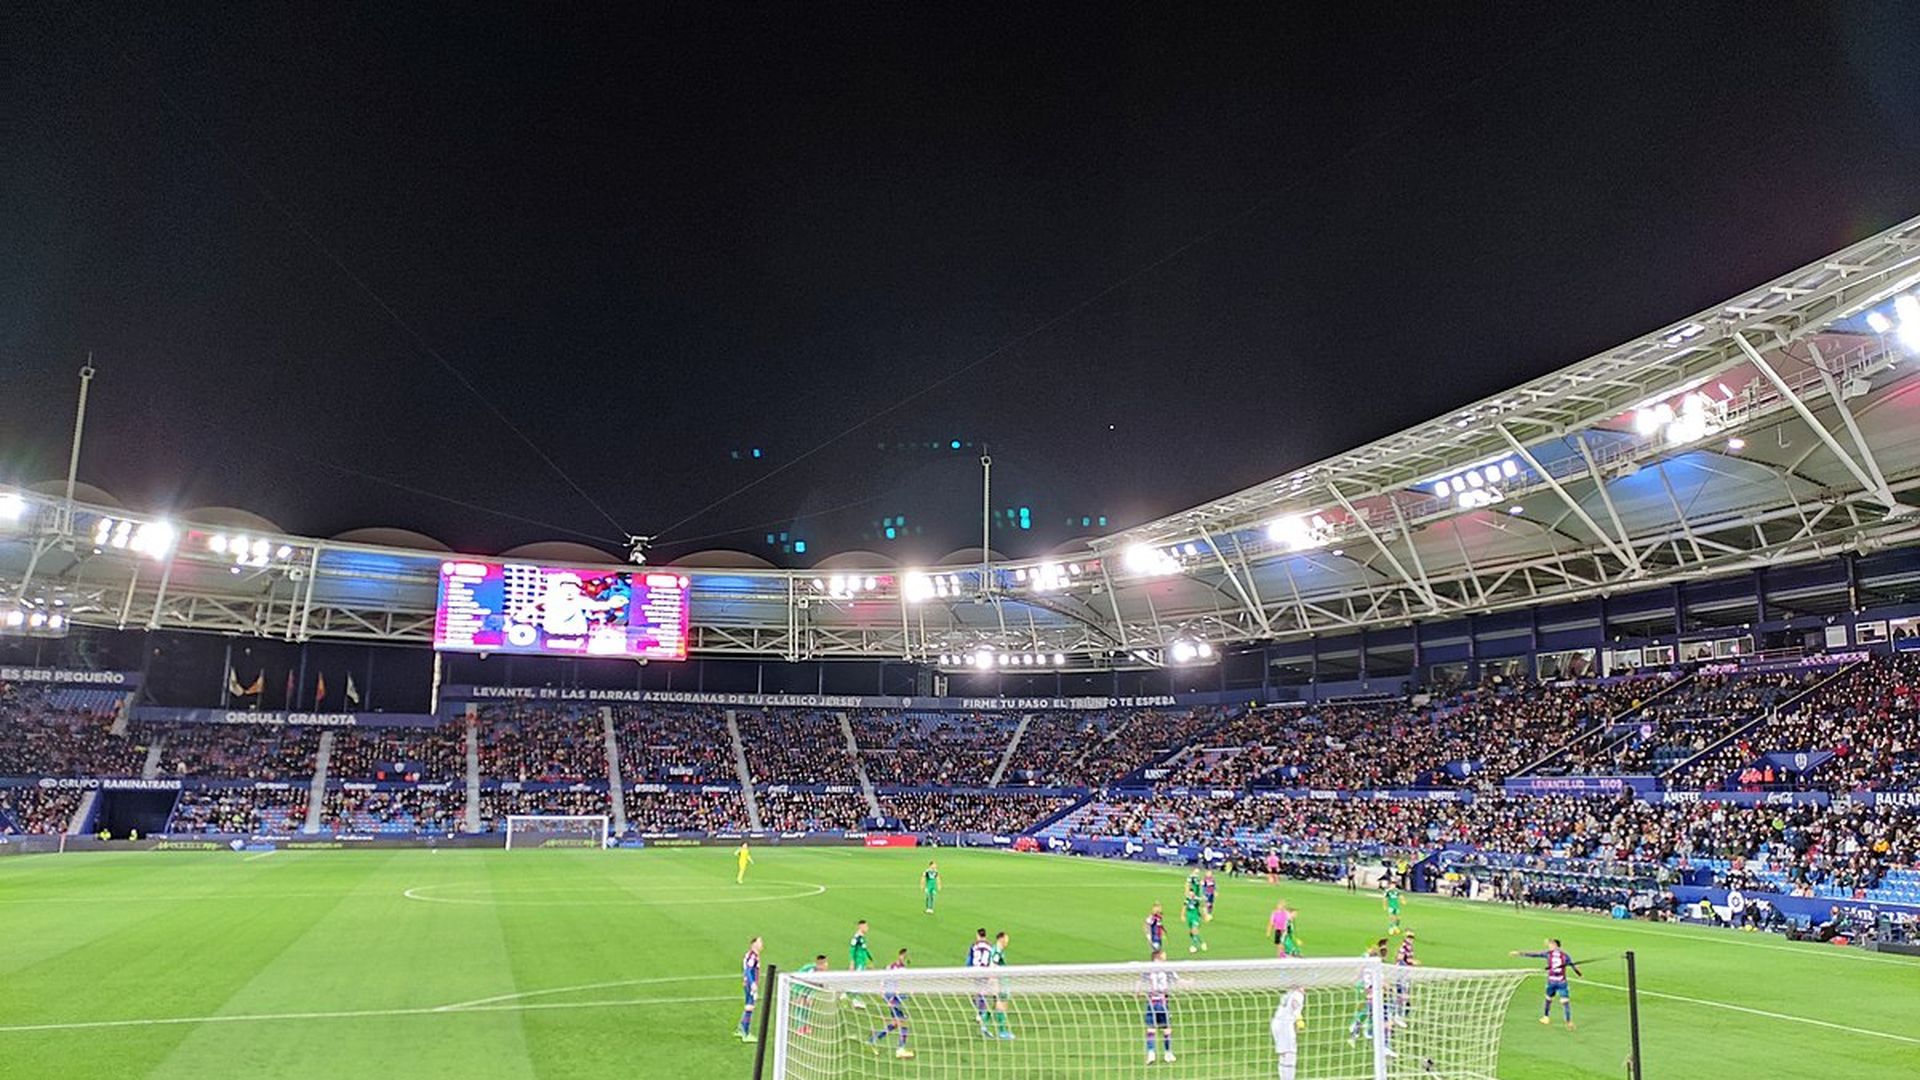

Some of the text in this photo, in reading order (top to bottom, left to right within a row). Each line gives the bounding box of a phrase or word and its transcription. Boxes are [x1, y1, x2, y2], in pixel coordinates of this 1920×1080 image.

[23, 669, 52, 682] SER
[54, 670, 125, 684] PEQUEÑO
[540, 689, 557, 698] EN
[561, 690, 586, 699] LAS
[589, 690, 640, 701] BARRAS
[643, 692, 725, 704] AZULGRANAS
[728, 694, 745, 704] DE
[748, 695, 764, 705] TU
[962, 700, 998, 709] FIRME
[1000, 699, 1016, 709] TU
[1018, 699, 1048, 709] PASO
[1053, 699, 1066, 709] EL
[1119, 698, 1133, 708] TE
[225, 711, 357, 726] ORGULL GRANOTA
[102, 780, 182, 790] RAMINATRANS
